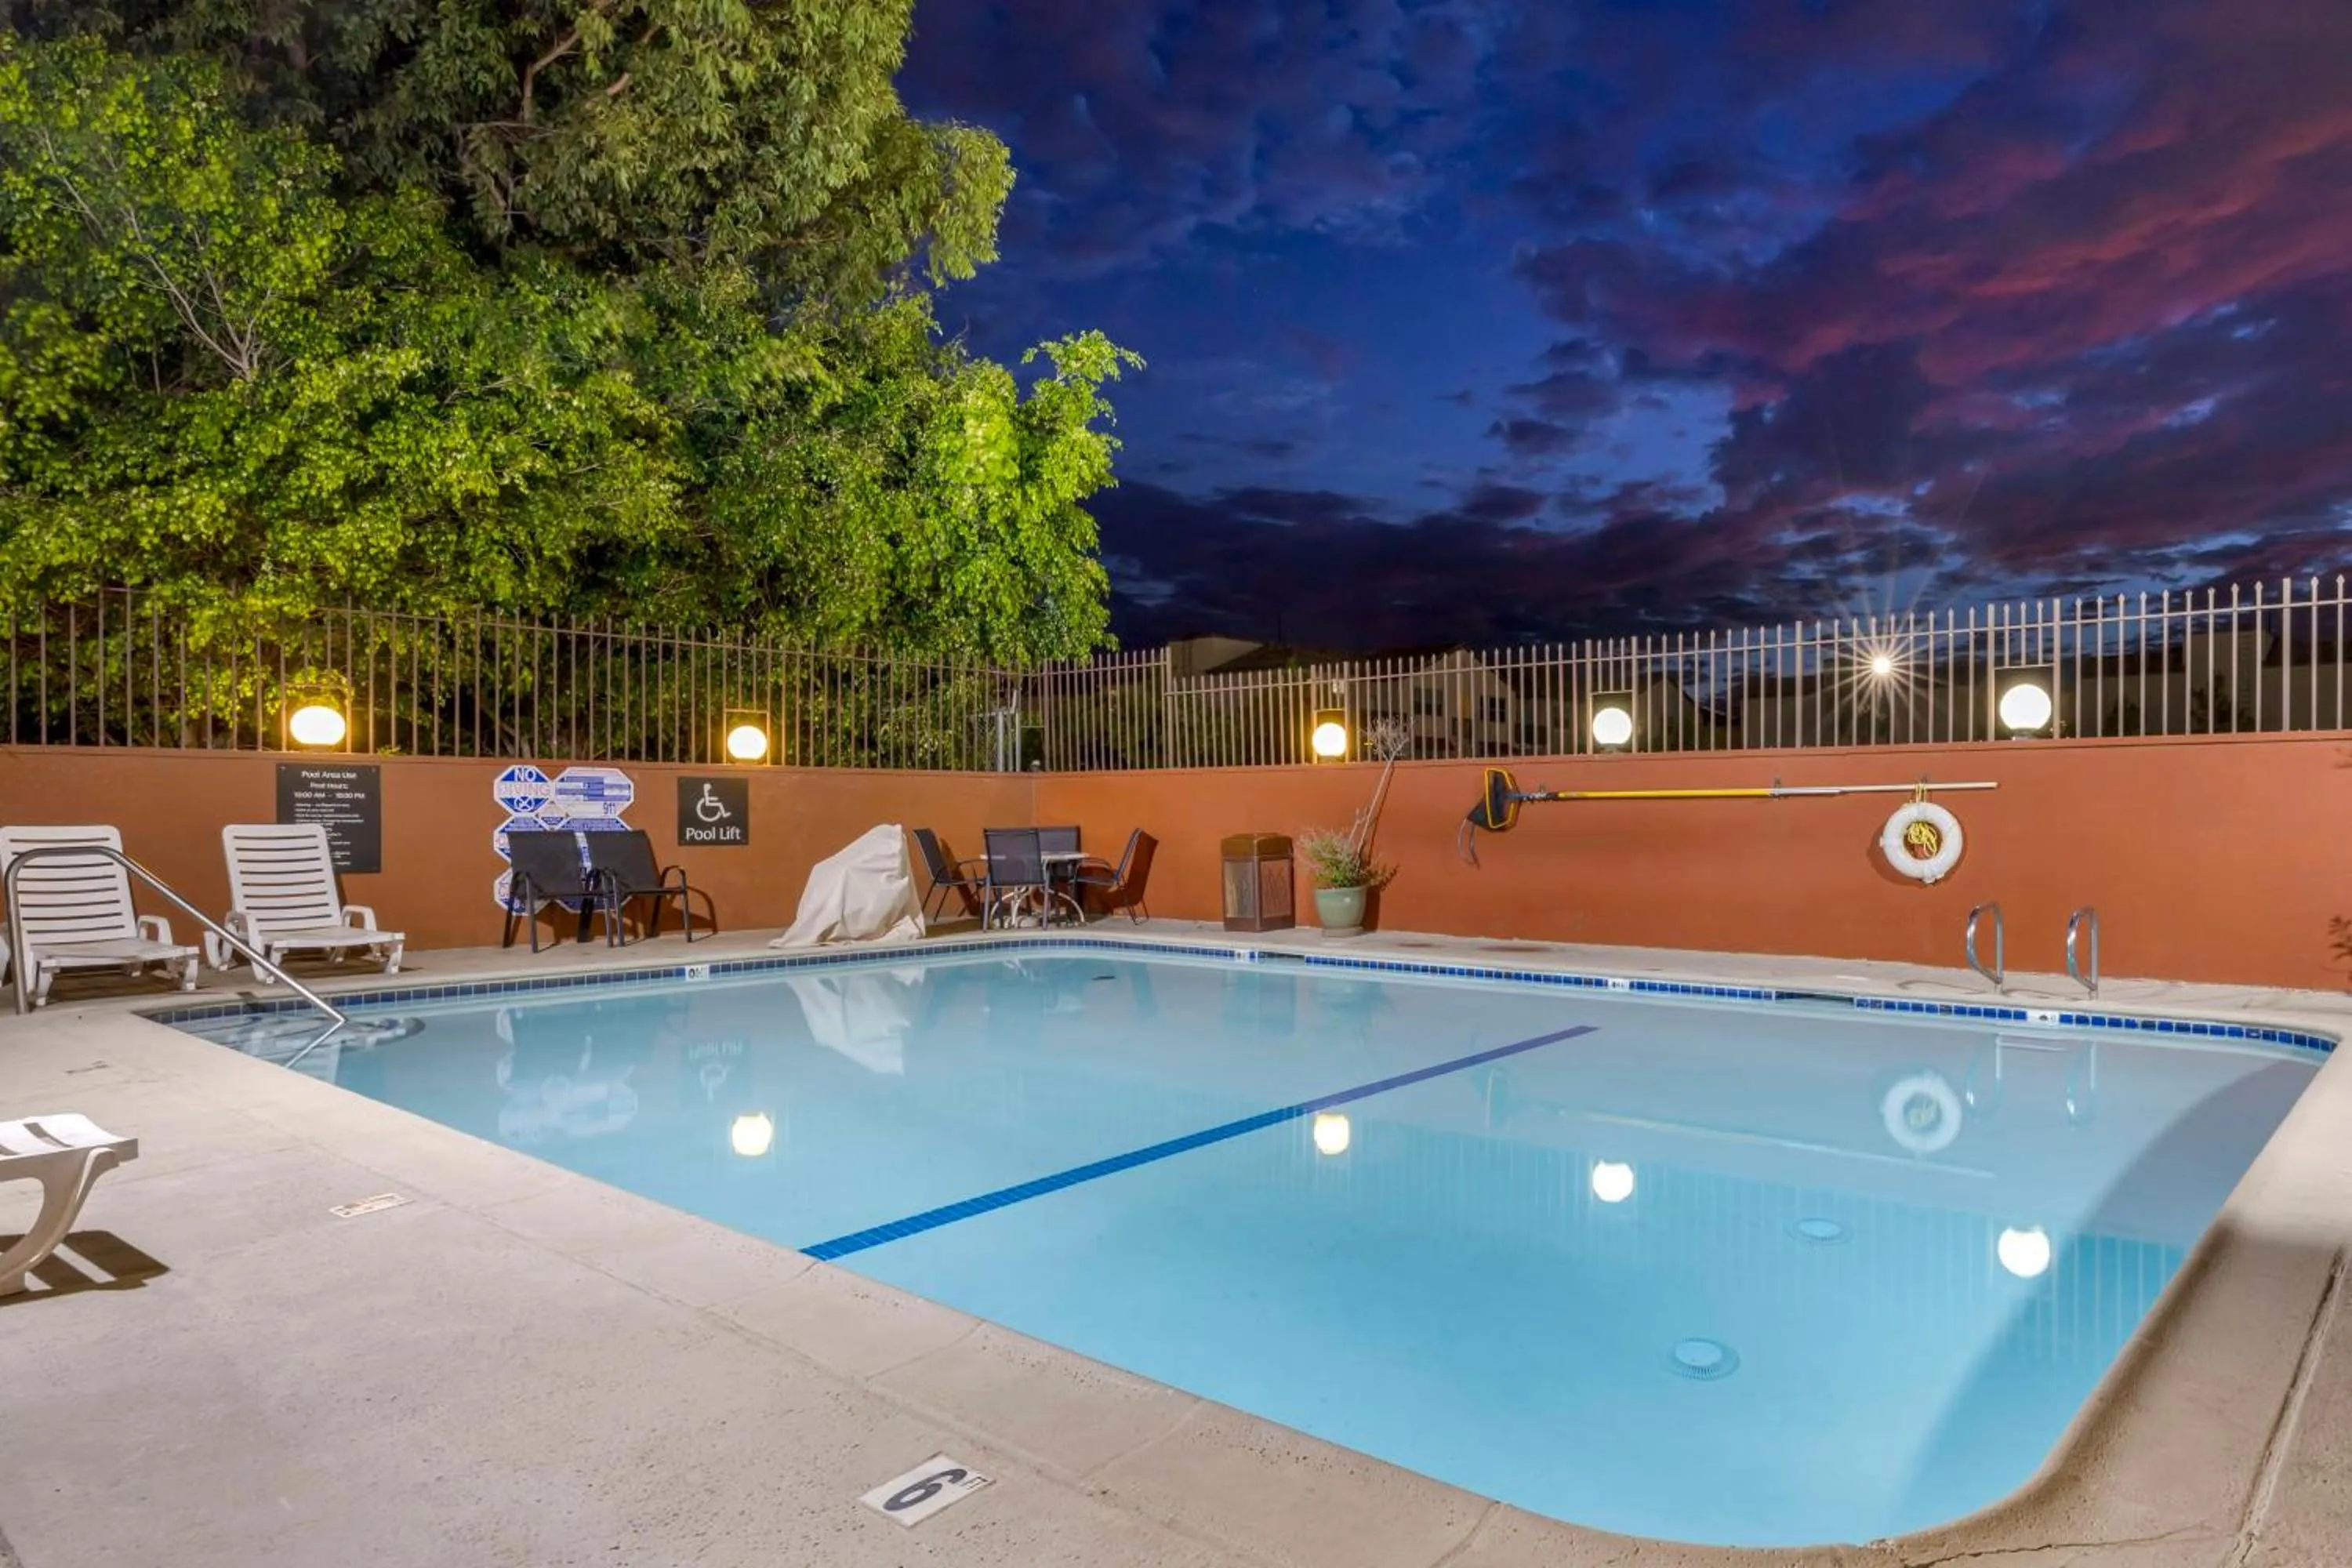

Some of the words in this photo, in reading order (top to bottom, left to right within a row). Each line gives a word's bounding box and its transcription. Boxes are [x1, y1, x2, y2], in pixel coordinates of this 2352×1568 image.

[514, 767, 536, 782] NO
[686, 826, 716, 840] Pool
[720, 826, 741, 840] Lift
[883, 1468, 967, 1511] 6
